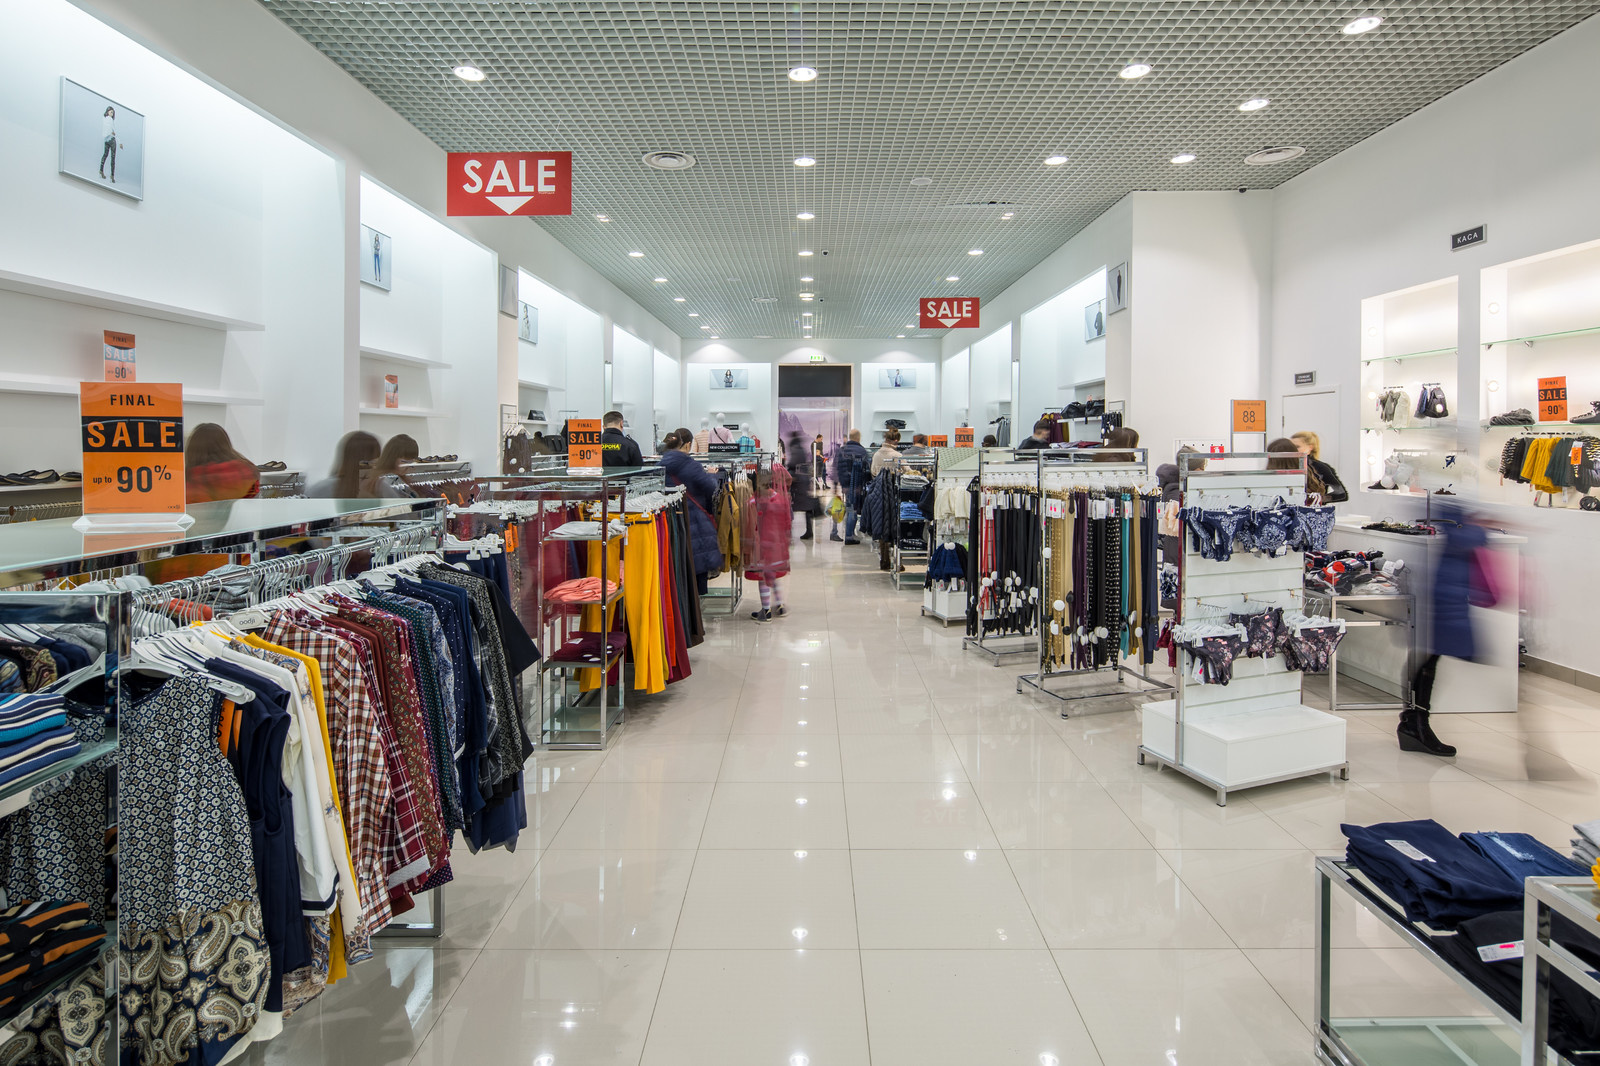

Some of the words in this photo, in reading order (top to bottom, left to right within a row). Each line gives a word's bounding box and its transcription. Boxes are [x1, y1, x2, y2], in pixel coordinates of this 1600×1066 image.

[462, 159, 556, 194] SALE
[1457, 232, 1478, 244] КАСА
[926, 300, 972, 318] SALE
[105, 347, 134, 361] SALE
[110, 394, 156, 407] FINAL
[1539, 389, 1565, 400] SALE
[1242, 410, 1256, 423] 88
[87, 421, 176, 448] SALE
[569, 432, 600, 444] SALE
[92, 476, 104, 485] up
[104, 475, 113, 484] to
[117, 465, 172, 493] 90%
